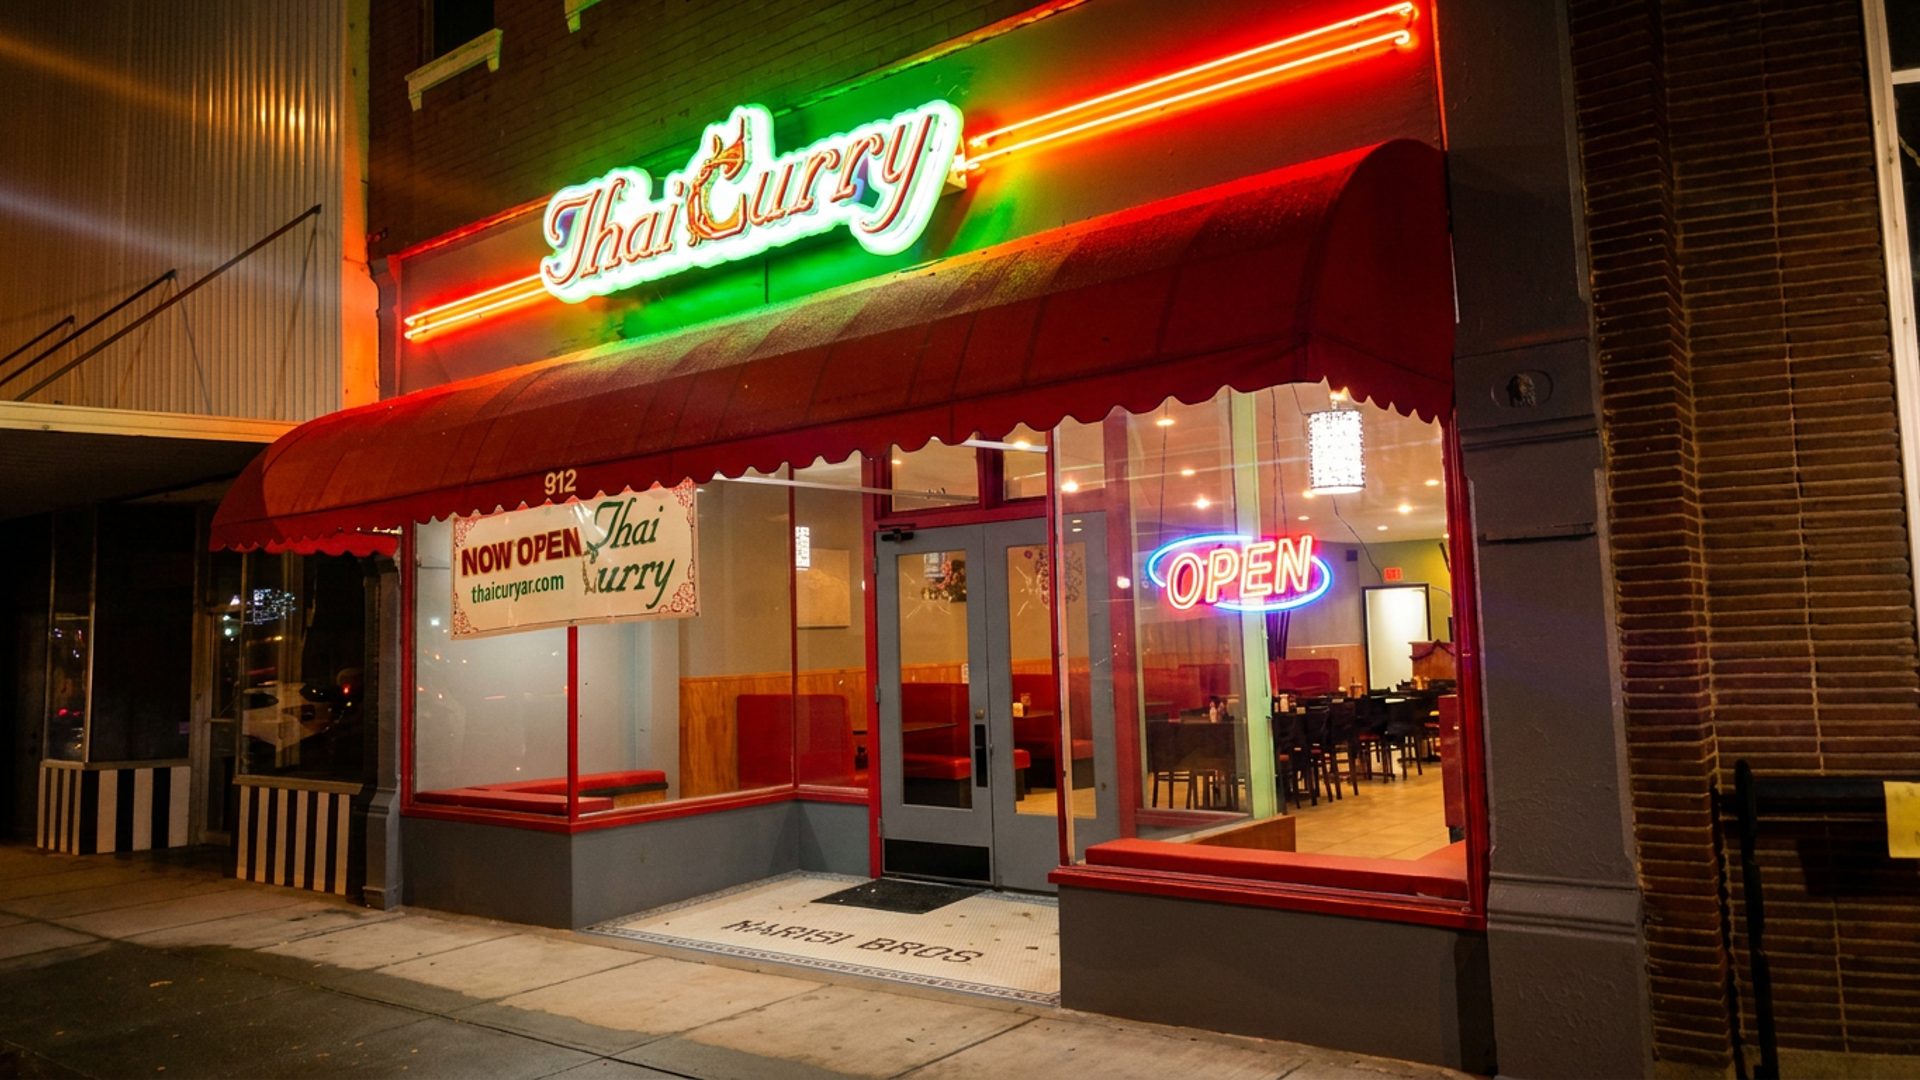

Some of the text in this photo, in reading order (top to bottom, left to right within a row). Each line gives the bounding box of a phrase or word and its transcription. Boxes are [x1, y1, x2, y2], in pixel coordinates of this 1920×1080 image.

[544, 113, 935, 286] Thai Curry
[544, 468, 577, 495] 912
[592, 496, 664, 550] Thai
[461, 526, 582, 577] NOW OPEN
[1166, 534, 1313, 610] OPEN
[471, 574, 564, 604] thaicuryar.com
[856, 937, 984, 962] BROS
